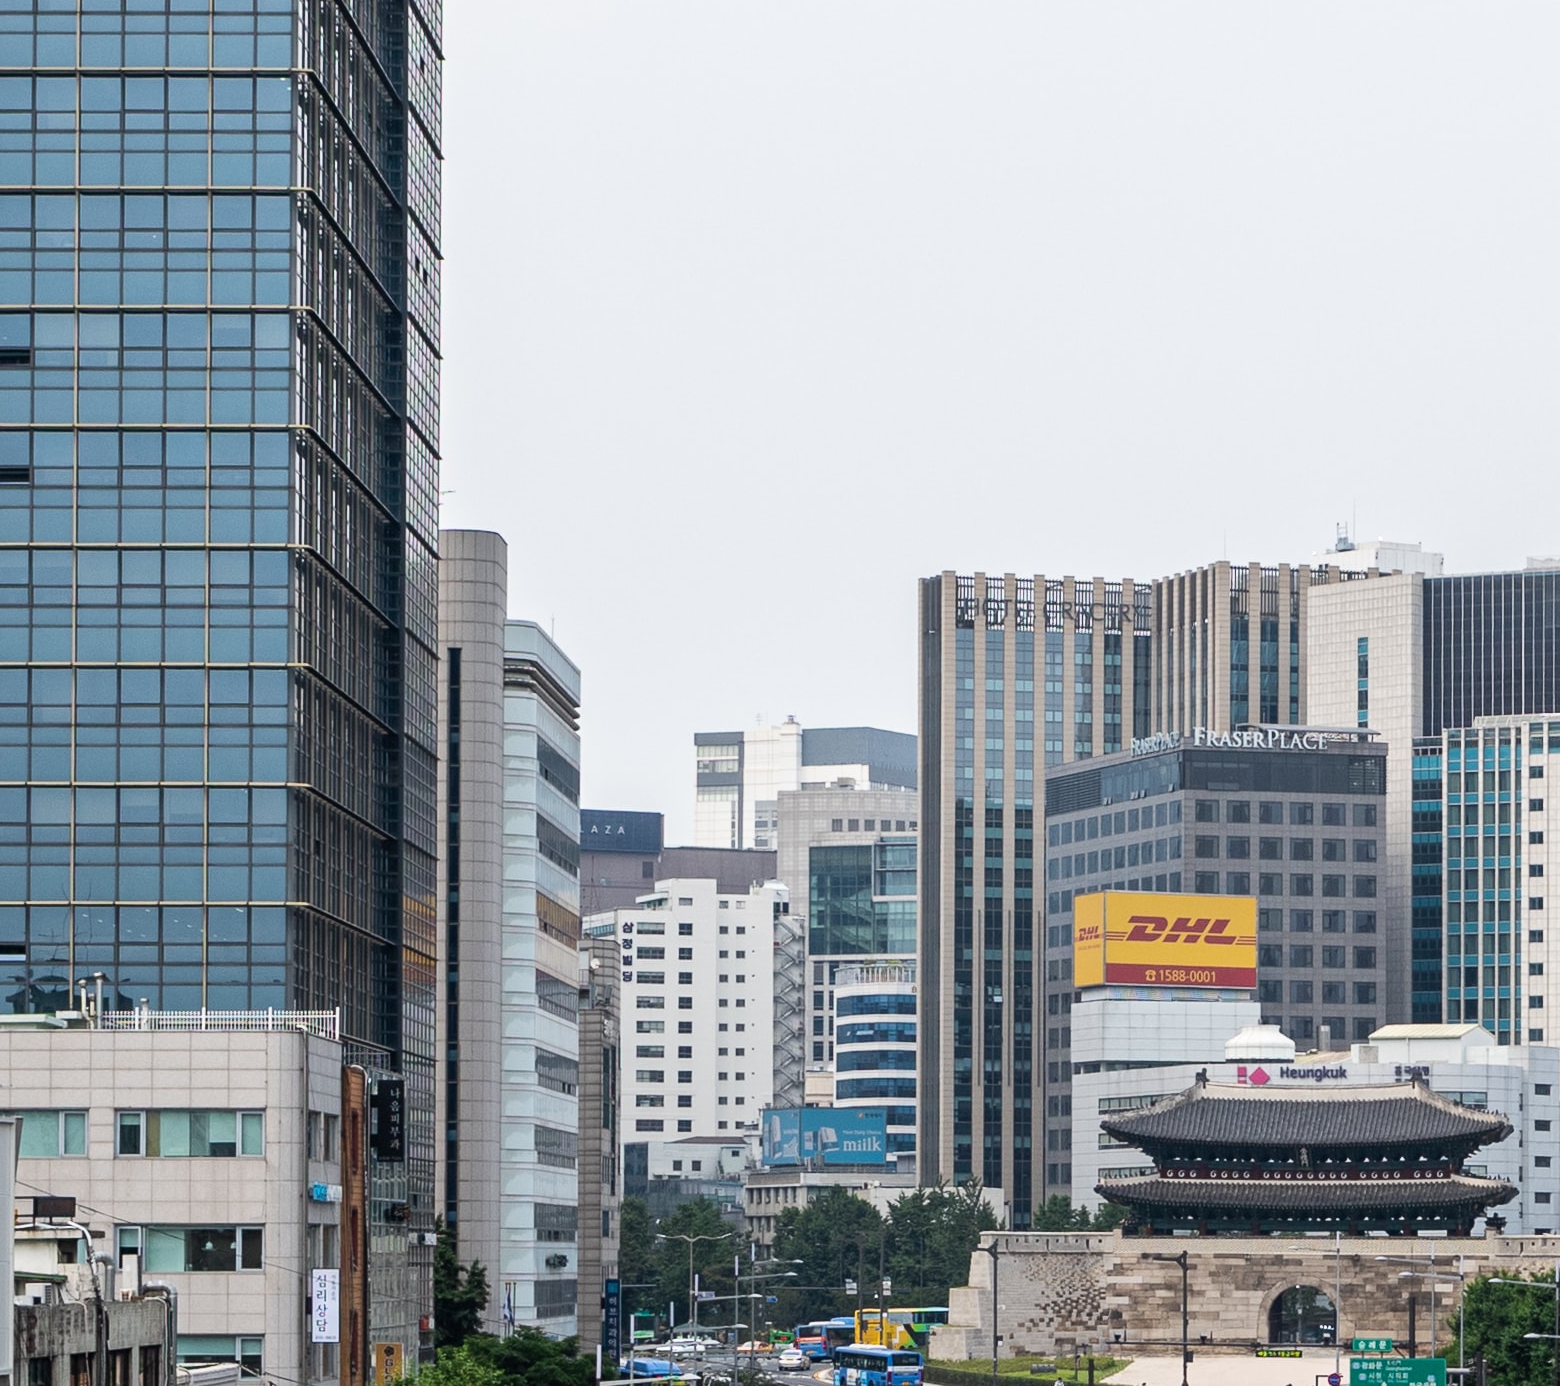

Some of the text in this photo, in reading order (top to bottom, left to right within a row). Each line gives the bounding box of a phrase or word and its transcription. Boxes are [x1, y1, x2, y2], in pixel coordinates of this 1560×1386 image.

[1126, 915, 1237, 946] DHL
[622, 921, 634, 982] 삼정빌딩
[1159, 969, 1216, 983] 1588-0001
[1280, 1065, 1348, 1082] Heungkuk
[315, 1273, 329, 1332] 심리상담
